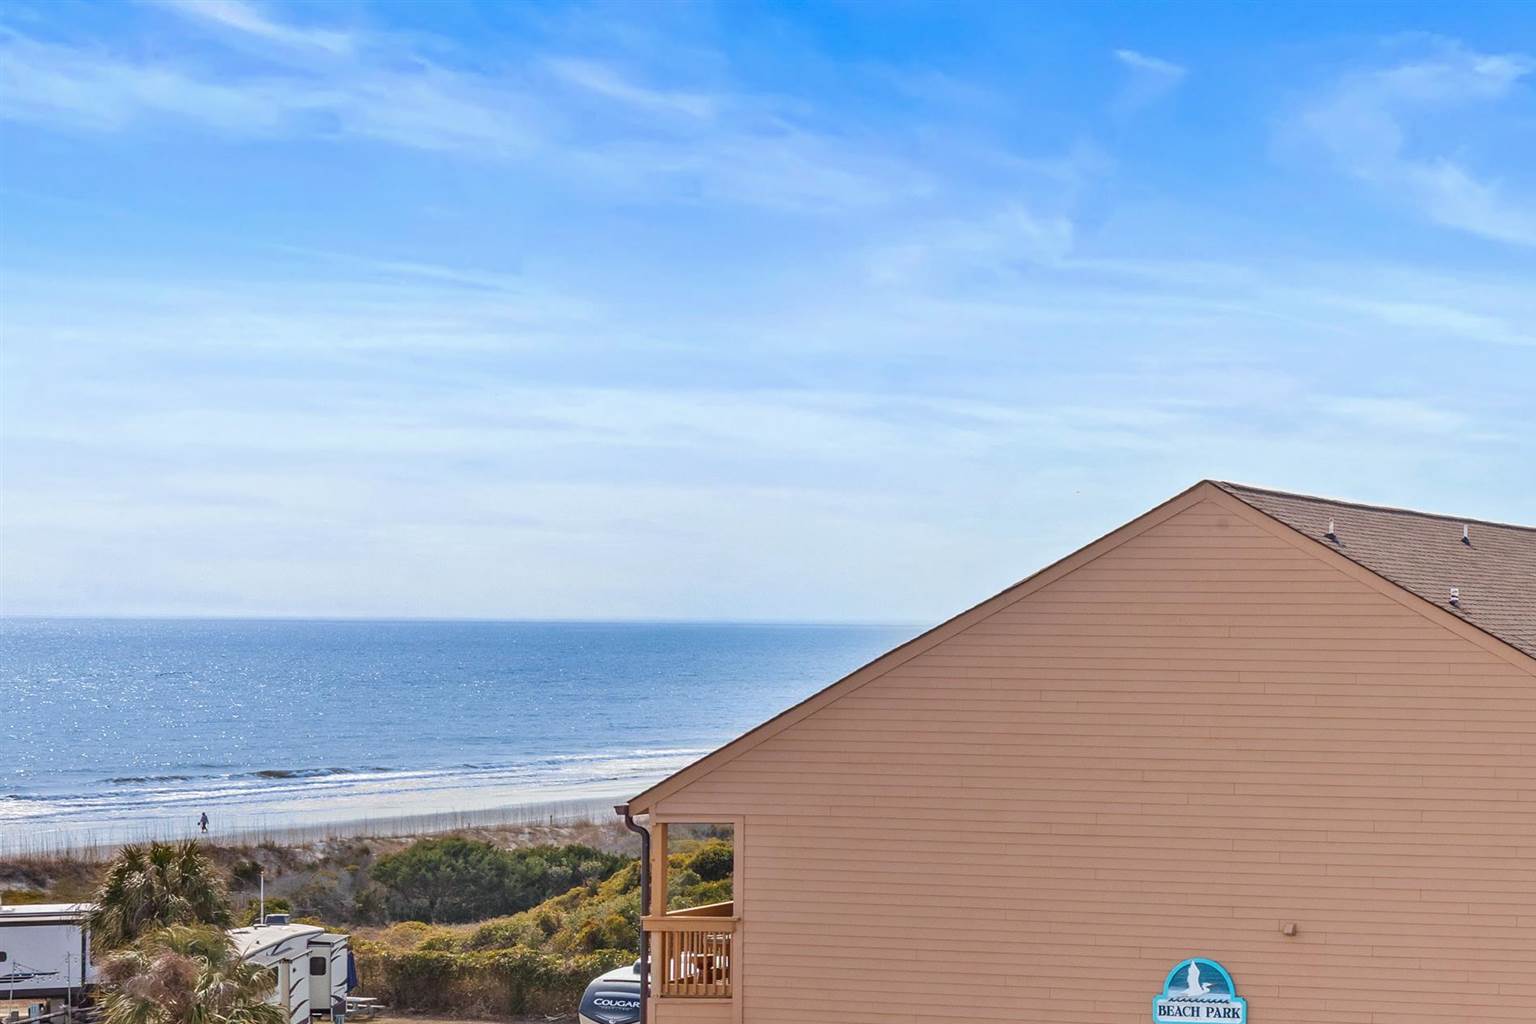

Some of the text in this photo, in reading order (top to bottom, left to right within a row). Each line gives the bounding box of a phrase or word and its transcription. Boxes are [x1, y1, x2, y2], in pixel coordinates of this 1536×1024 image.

[593, 998, 640, 1008] COUGAR
[1158, 1005, 1241, 1019] BEACH PARK
